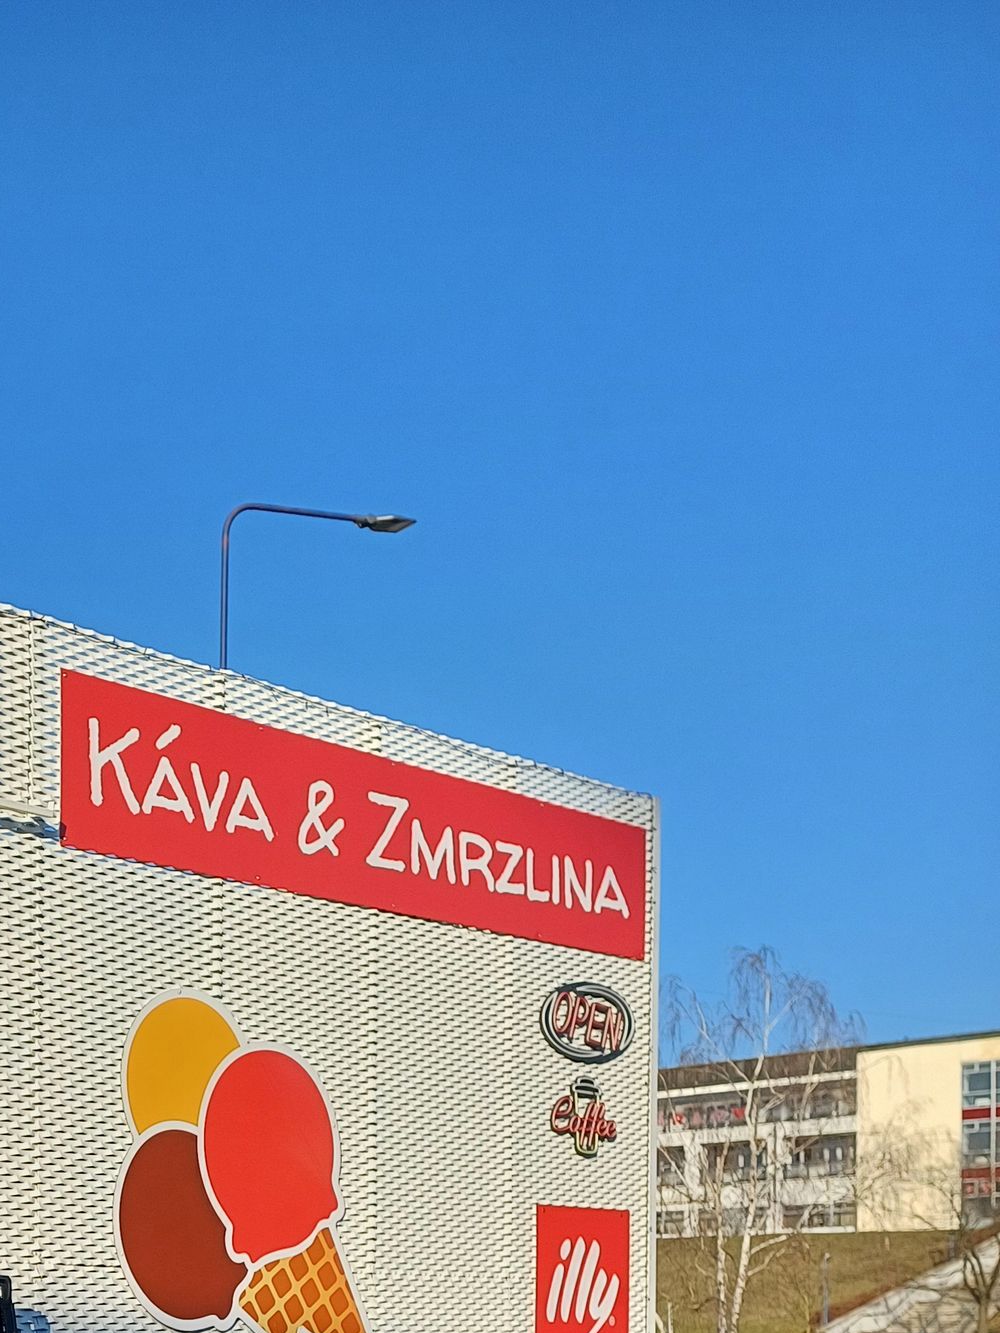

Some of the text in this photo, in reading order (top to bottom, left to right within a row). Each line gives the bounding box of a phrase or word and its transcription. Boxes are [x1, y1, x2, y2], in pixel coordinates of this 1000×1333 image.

[87, 716, 631, 920] KÁVA & ZMRZLINA
[551, 990, 625, 1052] OPEN
[550, 1094, 618, 1150] Coffee
